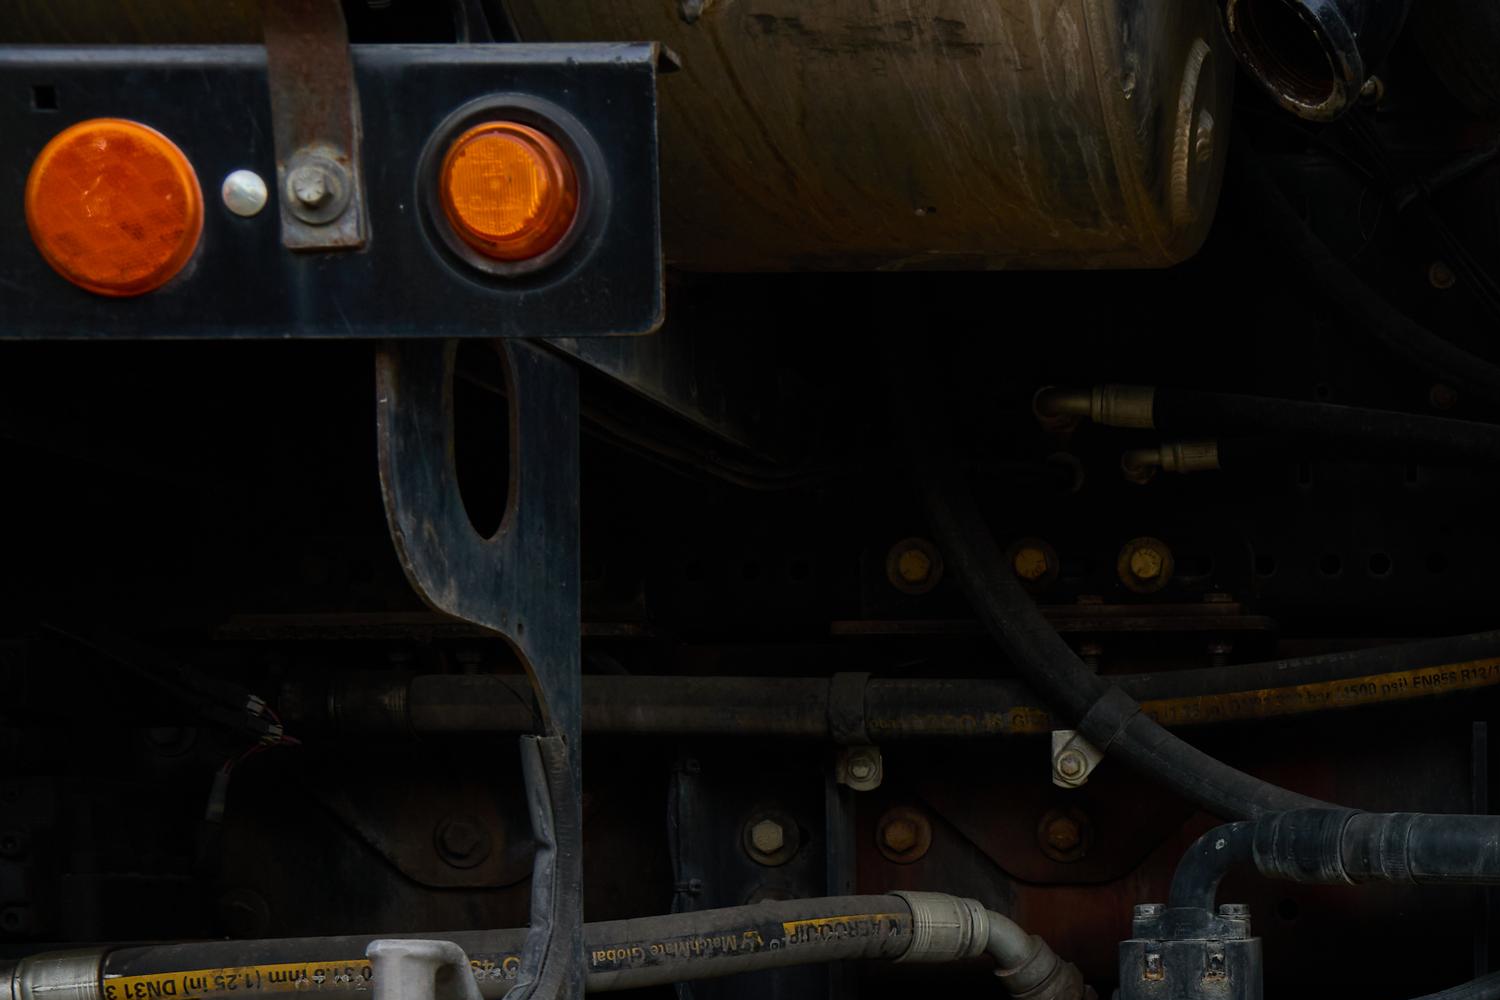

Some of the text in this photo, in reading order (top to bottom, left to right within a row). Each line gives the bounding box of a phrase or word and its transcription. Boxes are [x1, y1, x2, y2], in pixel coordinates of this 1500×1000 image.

[591, 945, 644, 967] Global
[183, 974, 208, 995] in)
[213, 970, 262, 990] (1.25
[268, 968, 307, 985] mm
[123, 978, 176, 1000] DN31
